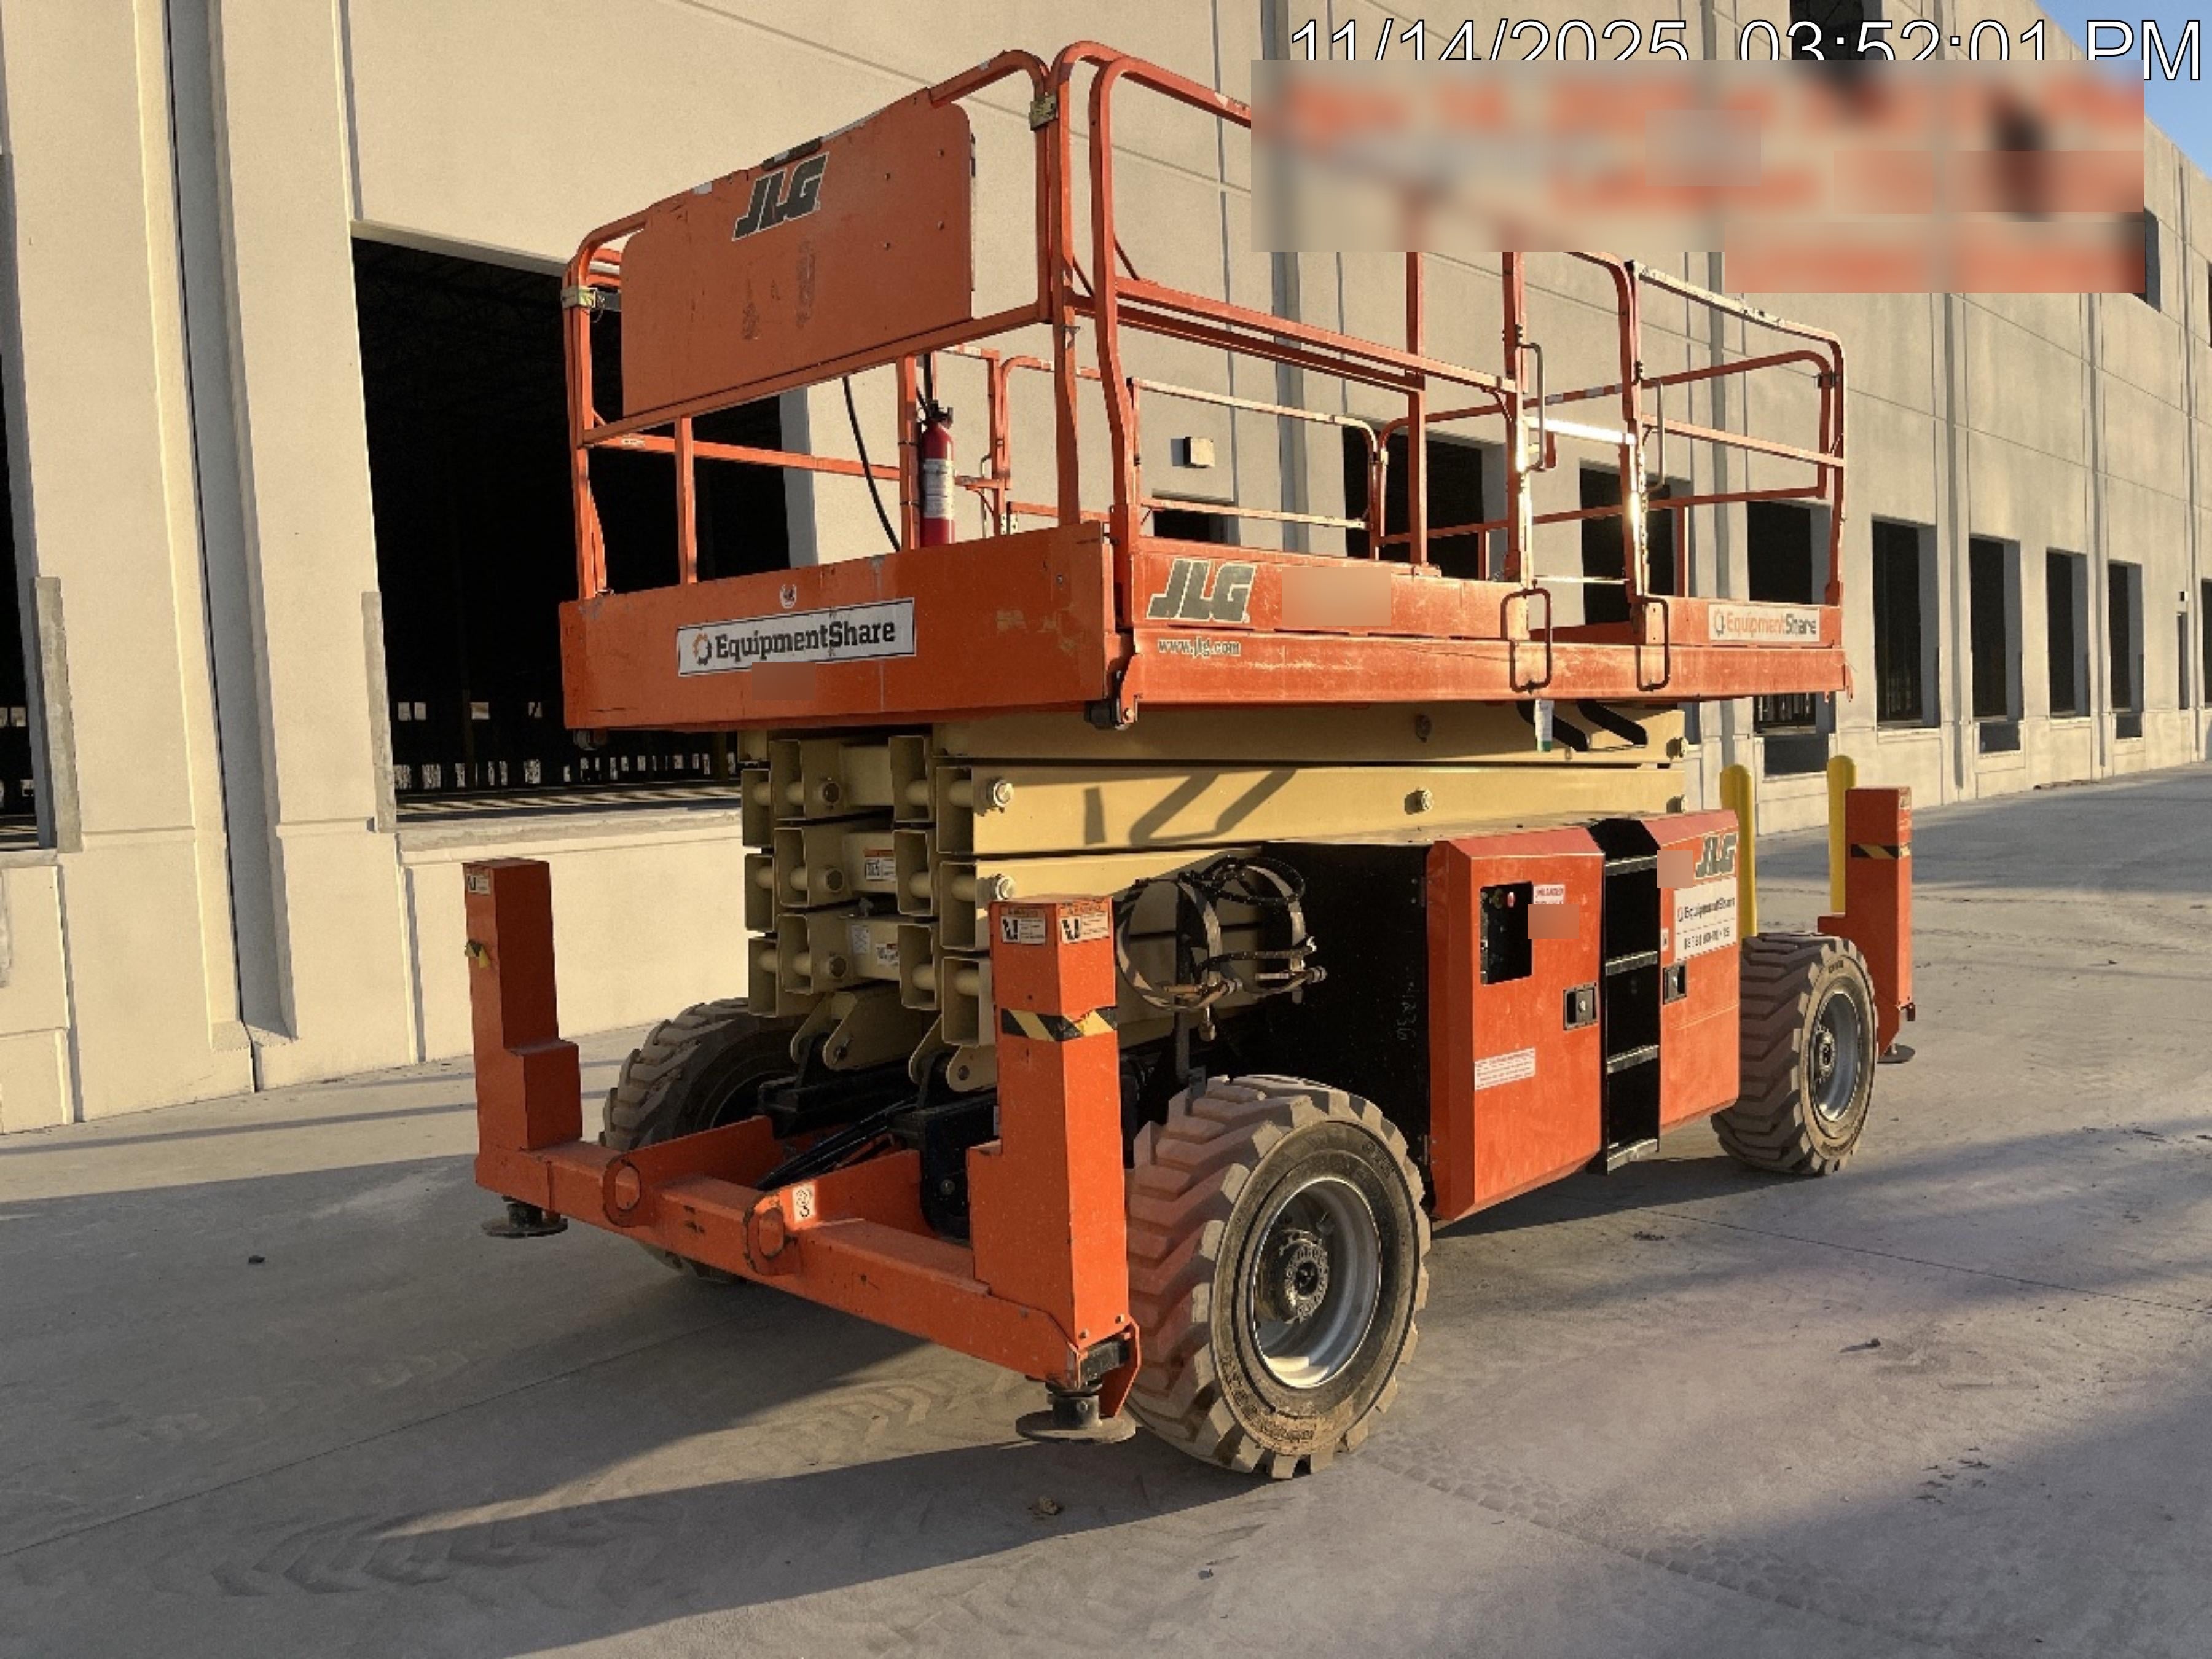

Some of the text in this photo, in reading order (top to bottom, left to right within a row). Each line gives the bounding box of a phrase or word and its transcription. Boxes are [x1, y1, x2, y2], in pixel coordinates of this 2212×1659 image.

[732, 151, 830, 241] JLG
[1146, 557, 1257, 623] JLG
[715, 620, 896, 662] EquipmentShare
[1158, 635, 1241, 659] www.jlg.com
[1693, 831, 1739, 880] JLG
